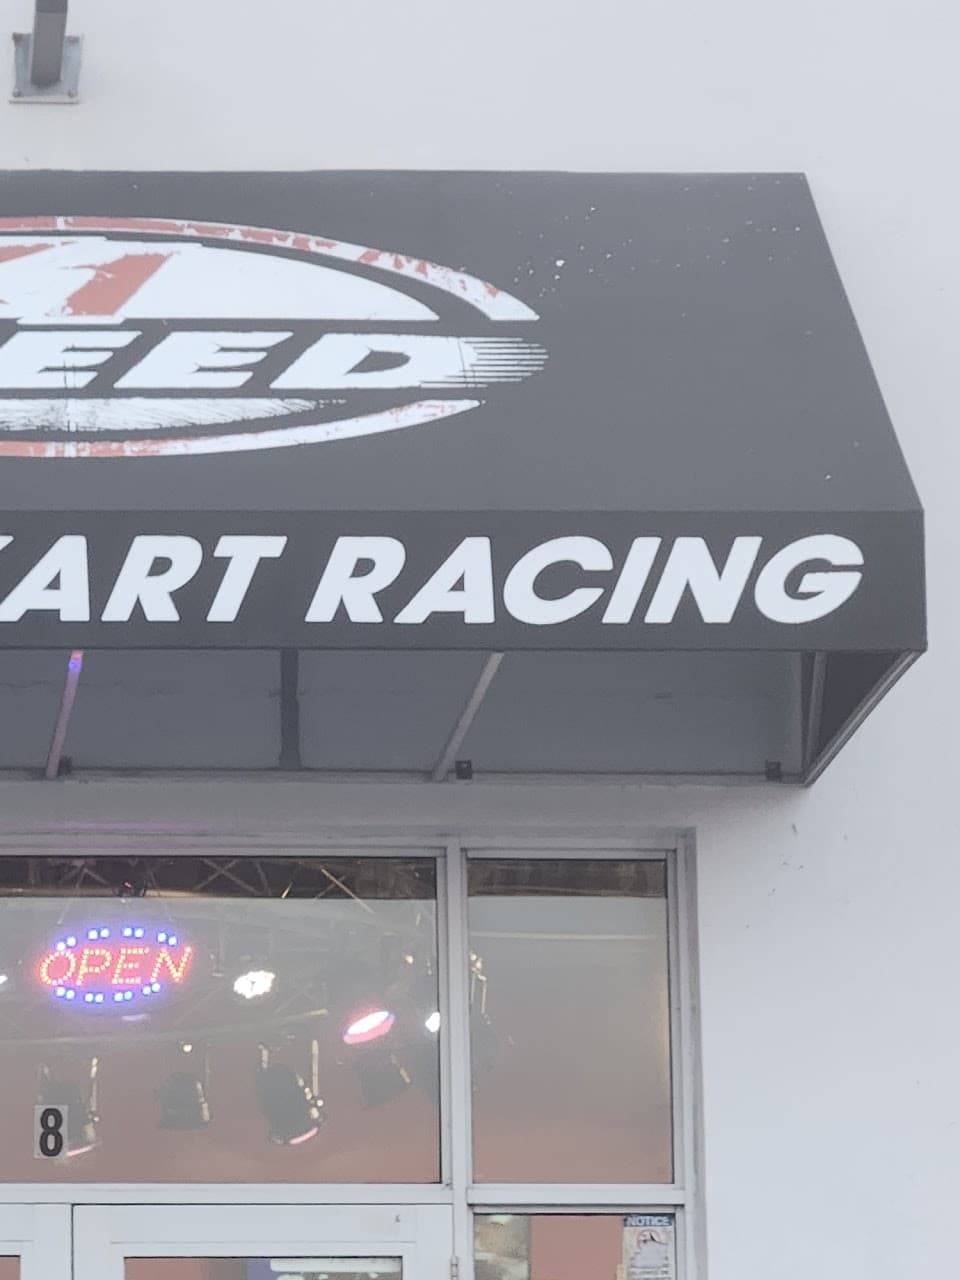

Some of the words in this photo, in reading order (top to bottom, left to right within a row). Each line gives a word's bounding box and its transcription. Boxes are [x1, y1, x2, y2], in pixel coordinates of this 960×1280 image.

[304, 533, 865, 625] RACING
[40, 946, 193, 987] OPEN
[39, 1107, 64, 1158] 8
[626, 1215, 671, 1226] NOTICE
